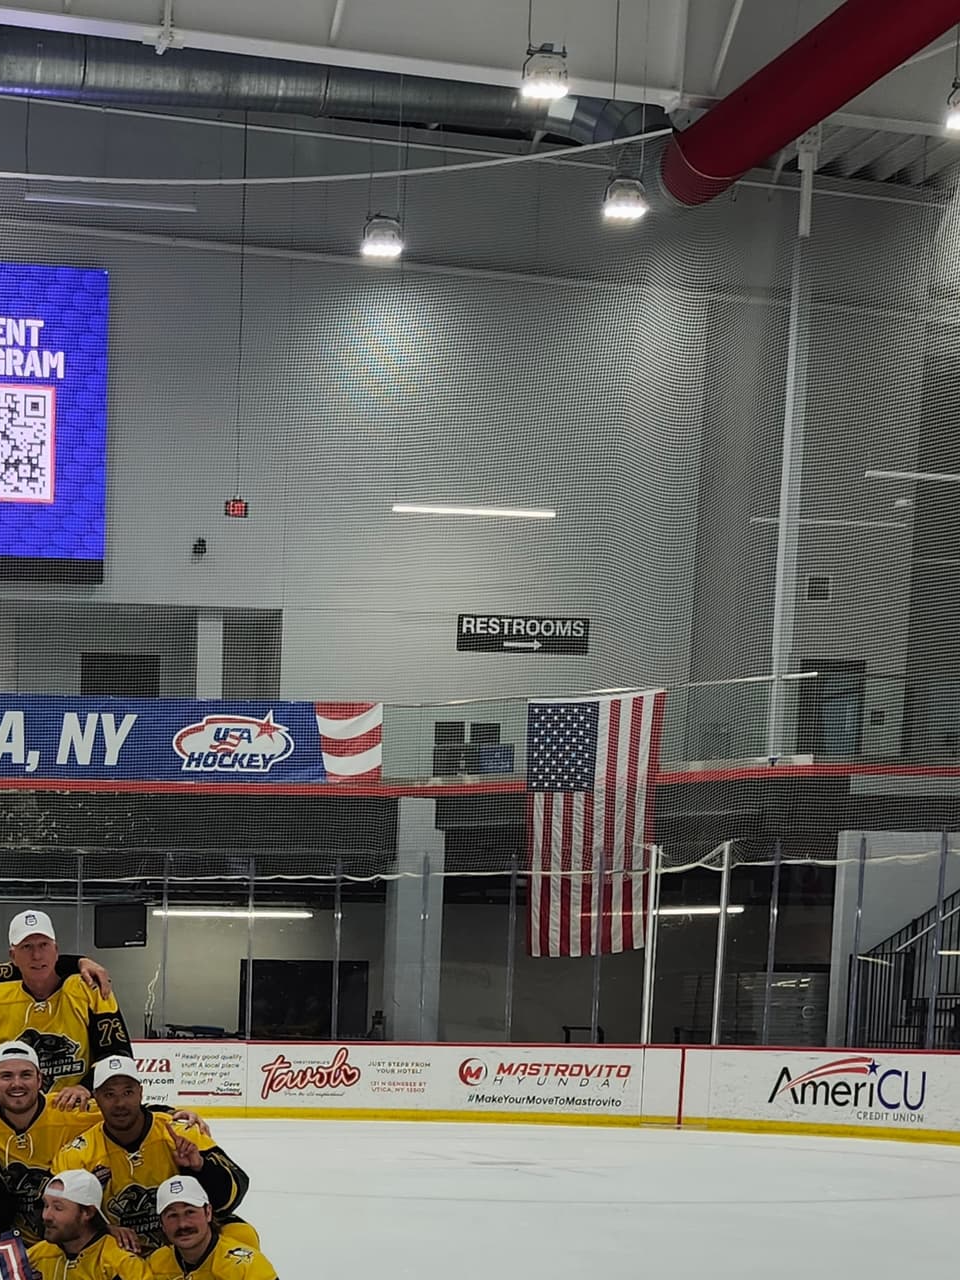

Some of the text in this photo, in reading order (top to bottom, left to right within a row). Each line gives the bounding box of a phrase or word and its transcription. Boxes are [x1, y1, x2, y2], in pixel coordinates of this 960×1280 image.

[461, 617, 585, 638] RESTROOMS
[55, 713, 138, 766] NY
[213, 727, 252, 743] USA
[185, 752, 276, 769] HOCKEY
[136, 1058, 172, 1073] zza
[496, 1062, 631, 1078] MASTROVITO
[493, 1076, 628, 1088] HYUNDAI
[768, 1066, 926, 1110] AmeriCU
[467, 1094, 622, 1107] #MakeYourMoveToMastrovito
[857, 1111, 924, 1122] CREDIT UNION
